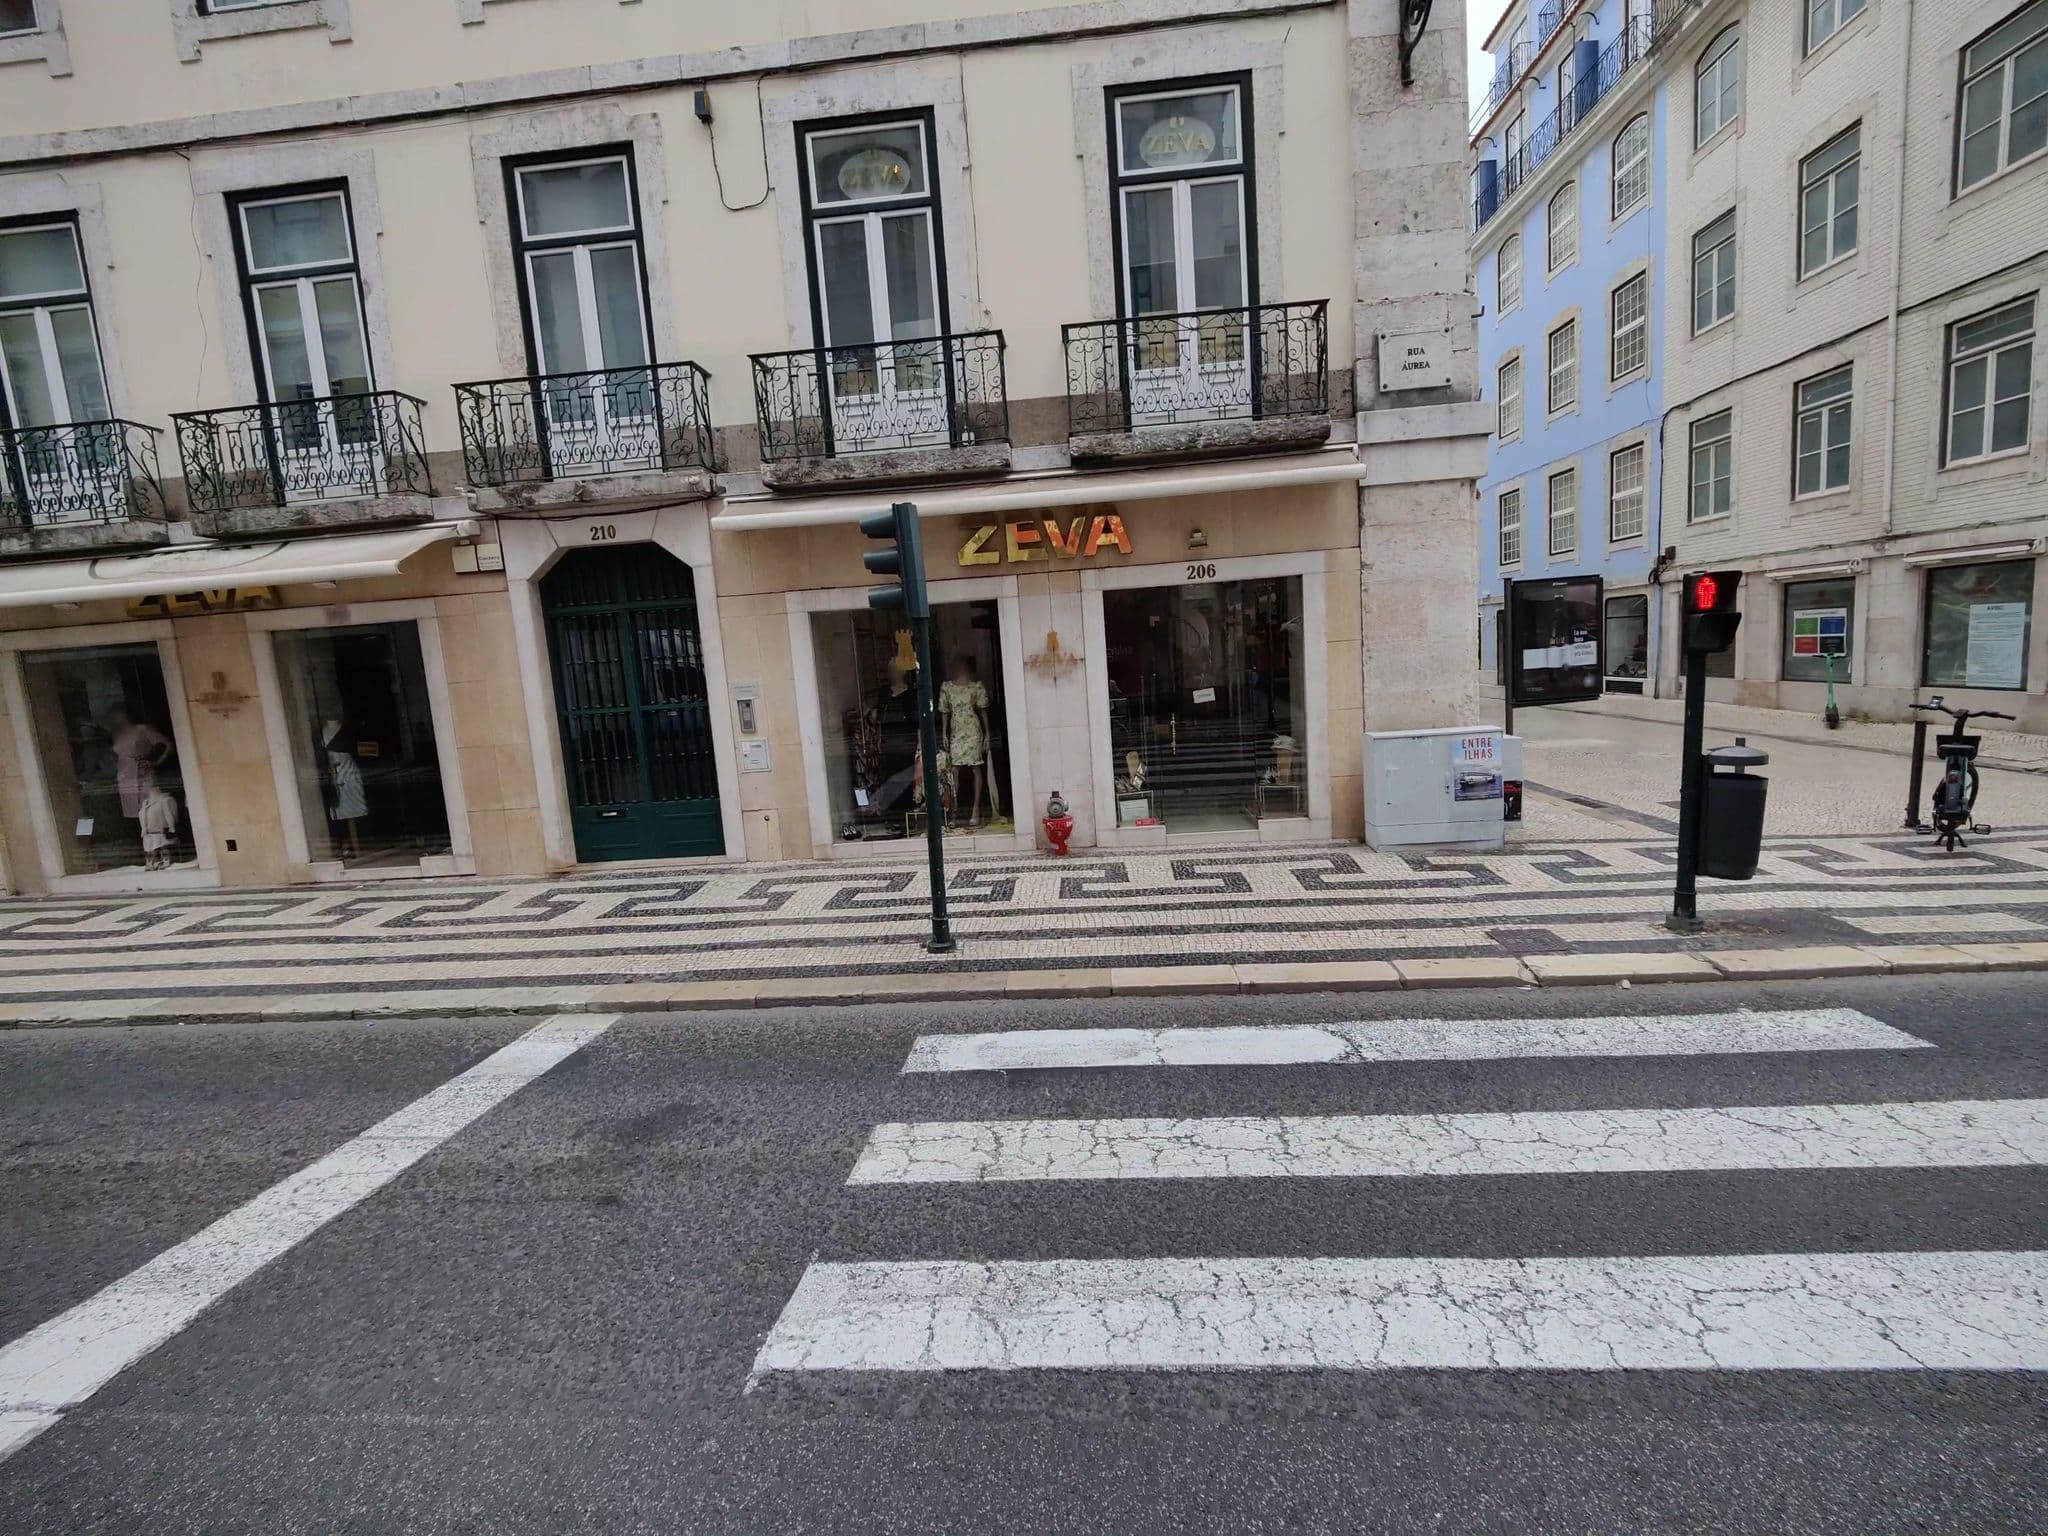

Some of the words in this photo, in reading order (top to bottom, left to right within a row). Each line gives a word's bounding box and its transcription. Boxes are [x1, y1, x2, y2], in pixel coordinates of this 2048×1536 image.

[1144, 131, 1211, 155] ZEVA
[1407, 347, 1426, 357] RUA
[1401, 360, 1431, 371] ÁUREA
[590, 525, 617, 541] 210
[957, 514, 1134, 567] ZEVA
[1186, 563, 1217, 580] 206
[1462, 737, 1493, 749] ENTRE
[1464, 748, 1493, 760] ILHAS
